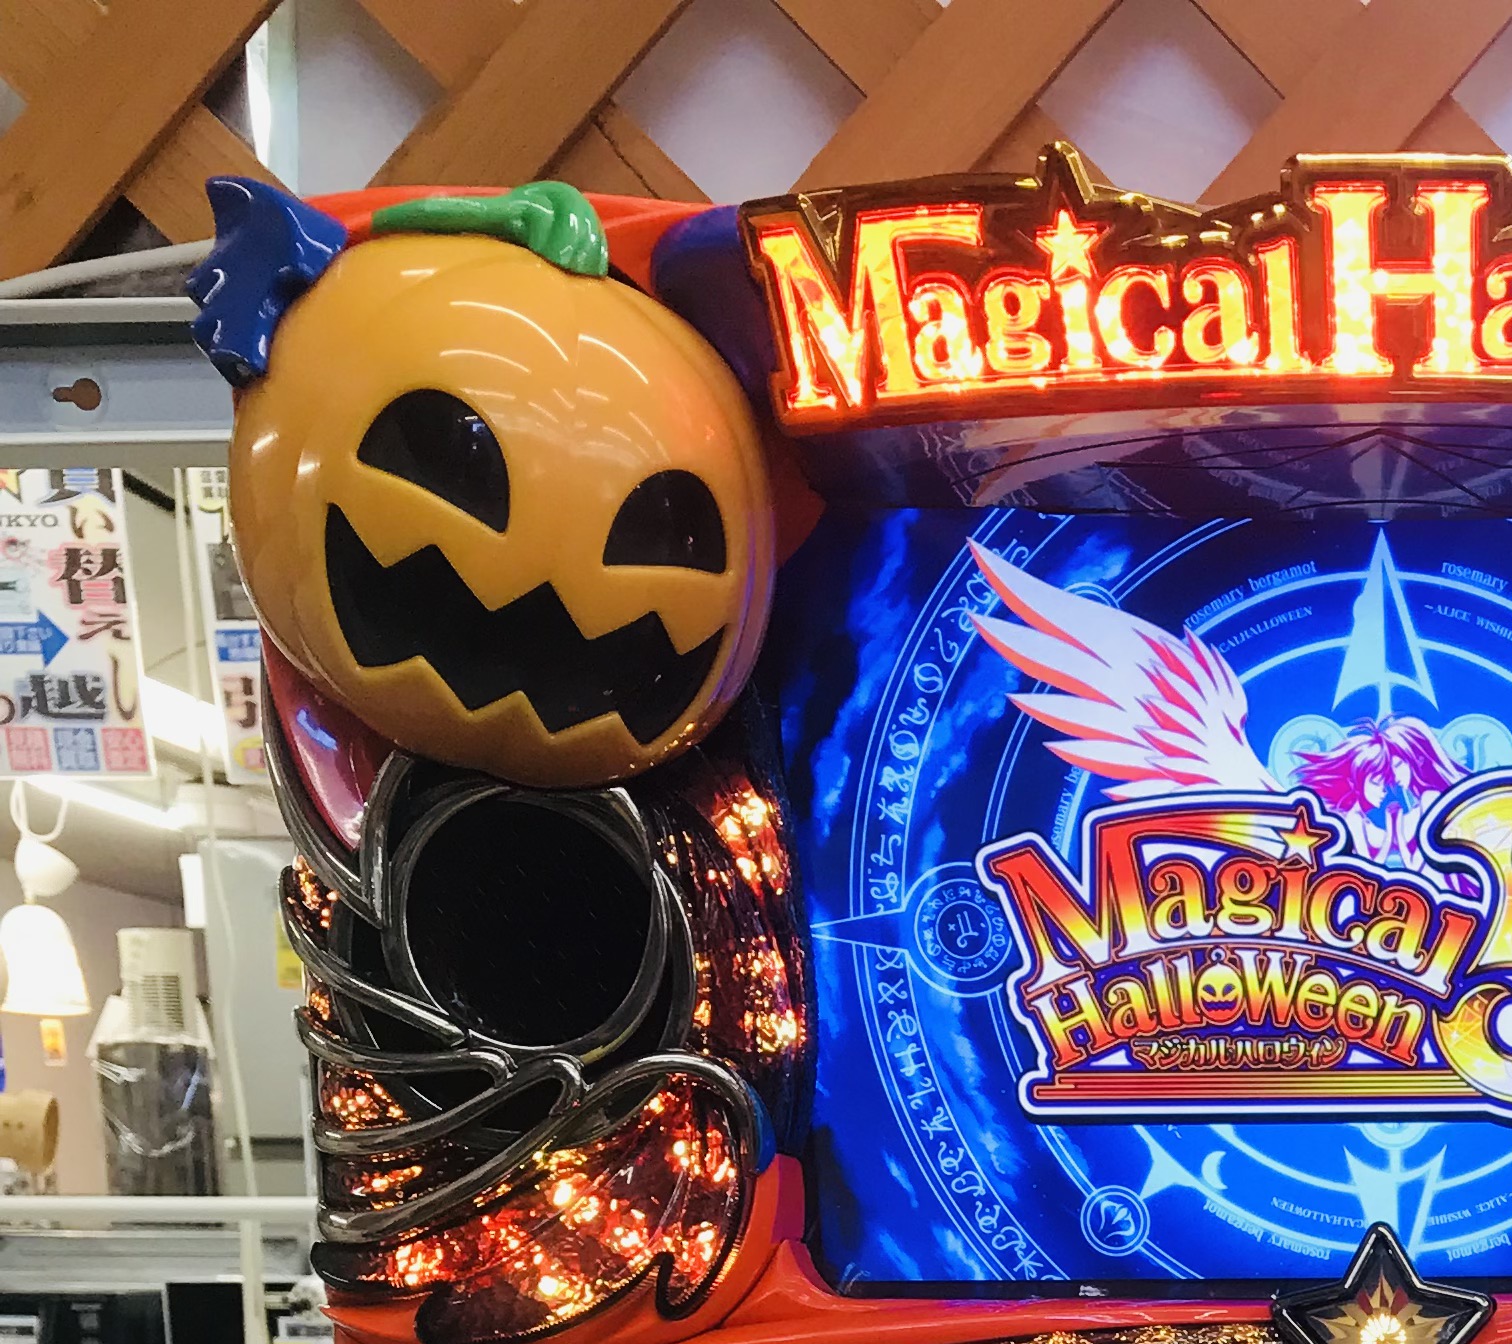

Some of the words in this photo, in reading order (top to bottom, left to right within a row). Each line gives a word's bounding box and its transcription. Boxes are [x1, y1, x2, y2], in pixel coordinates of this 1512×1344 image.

[755, 207, 1310, 410] Magical
[1440, 560, 1509, 594] rosemary
[993, 808, 1475, 997] Magical
[1131, 1036, 1345, 1070] マジカルハロウィン
